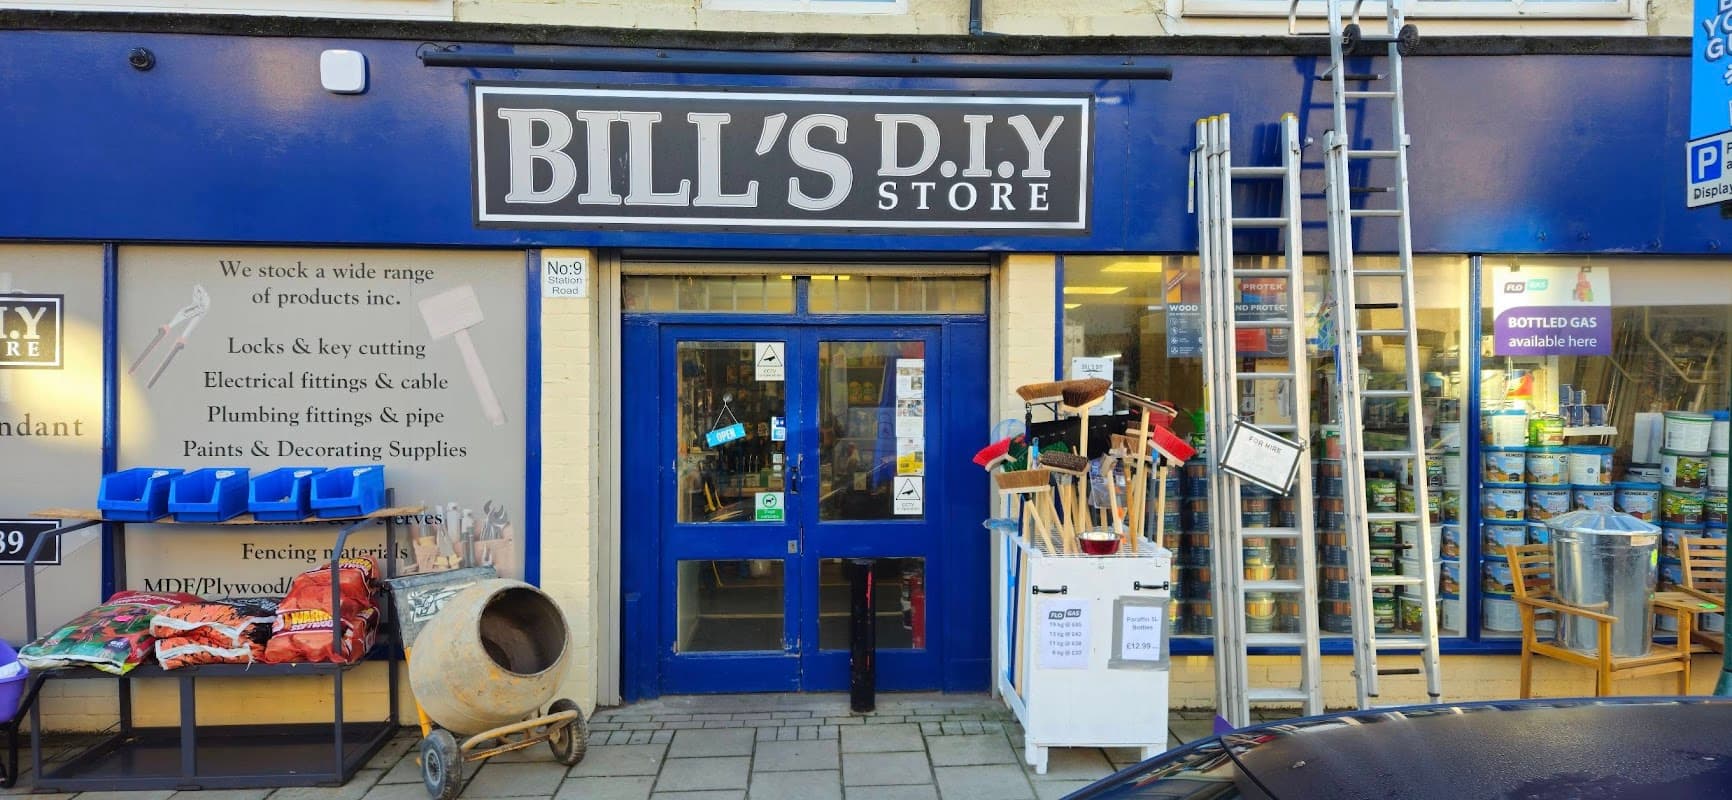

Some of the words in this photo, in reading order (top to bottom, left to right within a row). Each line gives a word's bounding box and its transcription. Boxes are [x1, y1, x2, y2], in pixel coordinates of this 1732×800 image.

[498, 107, 853, 211] BILL'S
[875, 113, 1064, 178] D.I.Y
[878, 181, 1049, 211] STORE
[220, 260, 251, 278] We
[259, 261, 308, 279] stock
[316, 267, 325, 279] a
[333, 262, 377, 279] wide
[384, 268, 435, 284] range
[548, 260, 582, 276] No:9
[548, 276, 582, 285] Station
[1505, 283, 1524, 292] FLO
[1528, 280, 1547, 289] GAS
[252, 286, 272, 304] of
[278, 287, 360, 308] products
[368, 288, 401, 305] inc.
[552, 286, 579, 295] Road
[1169, 304, 1199, 312] WOOD
[1508, 316, 1567, 329] BOTTLED
[1570, 316, 1598, 329] GAS
[228, 337, 285, 354] Locks
[292, 337, 311, 355] &
[320, 337, 352, 359] key
[359, 338, 426, 360] cutting
[1508, 334, 1565, 348] available
[1568, 334, 1598, 348] here
[203, 371, 294, 389] Electrical
[301, 371, 368, 393] fittings
[375, 372, 393, 389] &
[401, 372, 448, 390] cable
[208, 405, 300, 427] Plumbing
[306, 406, 372, 427] fittings
[380, 406, 399, 424] &
[406, 407, 445, 428] pipe
[716, 427, 737, 442] OPEN
[1249, 435, 1263, 447] FOR
[183, 440, 243, 457] Paints
[251, 440, 270, 457] &
[278, 440, 382, 461] Decorating
[389, 440, 467, 462] Supplies
[242, 543, 317, 563] Fencing
[1126, 642, 1151, 650] £12.99
